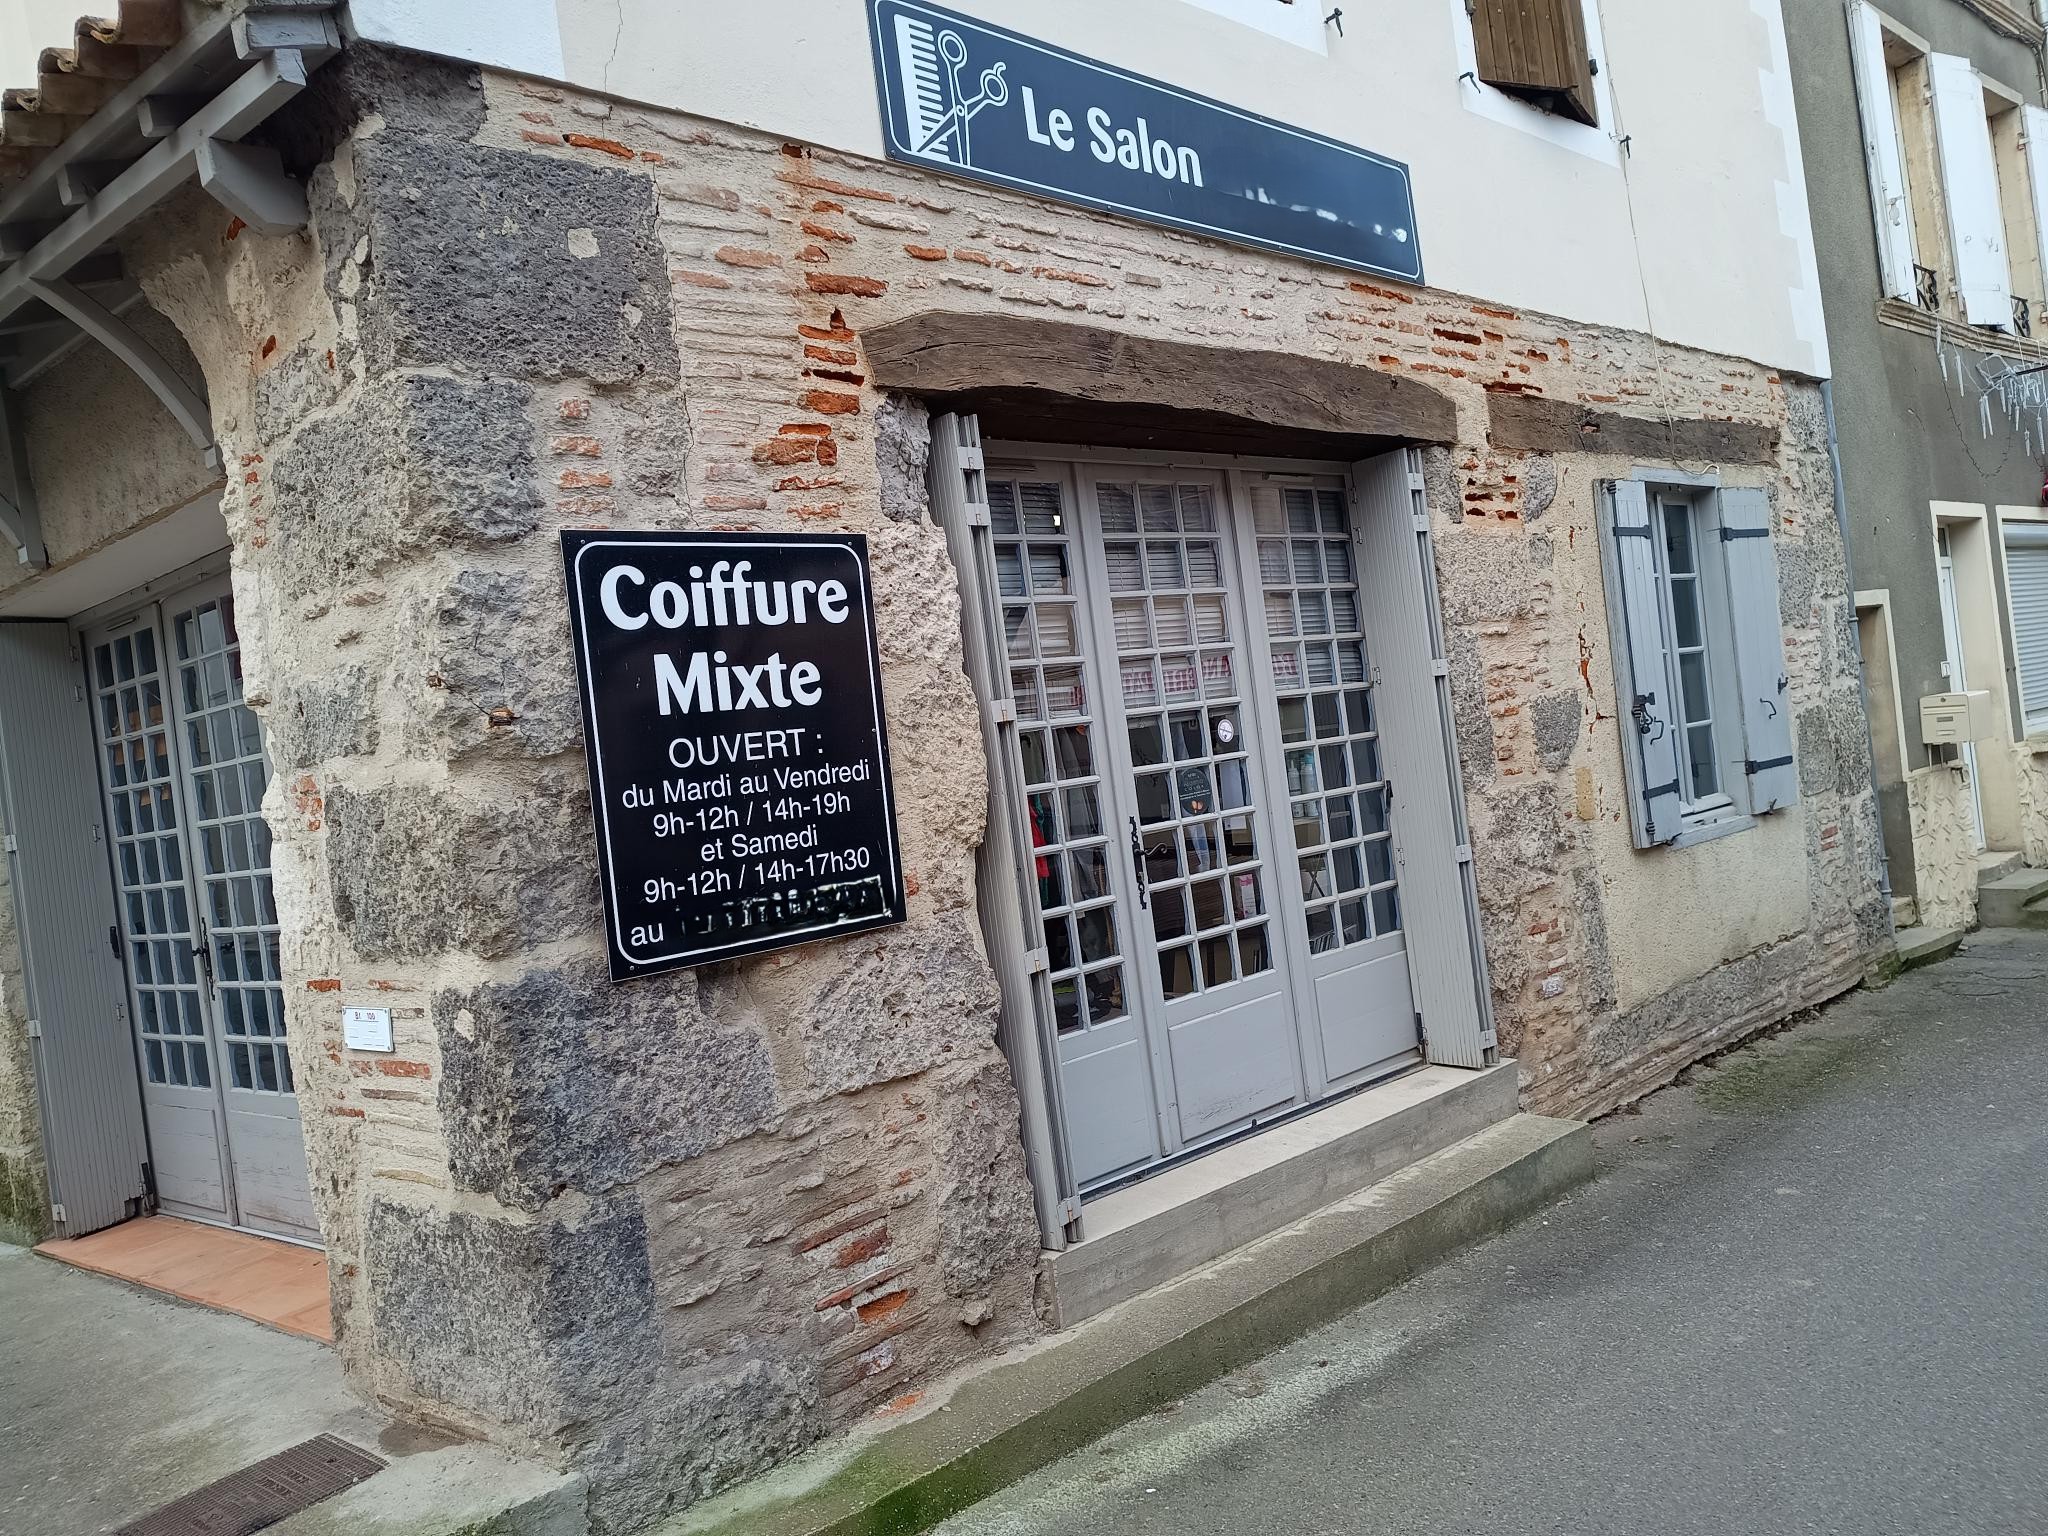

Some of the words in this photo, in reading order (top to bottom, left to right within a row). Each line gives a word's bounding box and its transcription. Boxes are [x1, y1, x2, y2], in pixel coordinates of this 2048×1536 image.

[1021, 86, 1075, 152] Le
[1086, 106, 1204, 188] Salon
[600, 560, 850, 631] Coiffure
[654, 650, 823, 716] Mixte
[668, 728, 806, 769] OUVERT
[816, 733, 823, 754] :
[622, 783, 655, 809] du
[663, 774, 731, 805] Mardi
[740, 776, 768, 797] au
[773, 759, 870, 791] Vendredi
[653, 803, 739, 838] 9h-12h
[746, 802, 754, 826] /
[763, 791, 851, 823] 14h-19h
[701, 842, 725, 862] et
[731, 823, 819, 858] Samedi
[643, 871, 731, 904] 9h-12h
[738, 864, 746, 888] /
[754, 846, 870, 886] 14h-17h30
[630, 921, 664, 947] au
